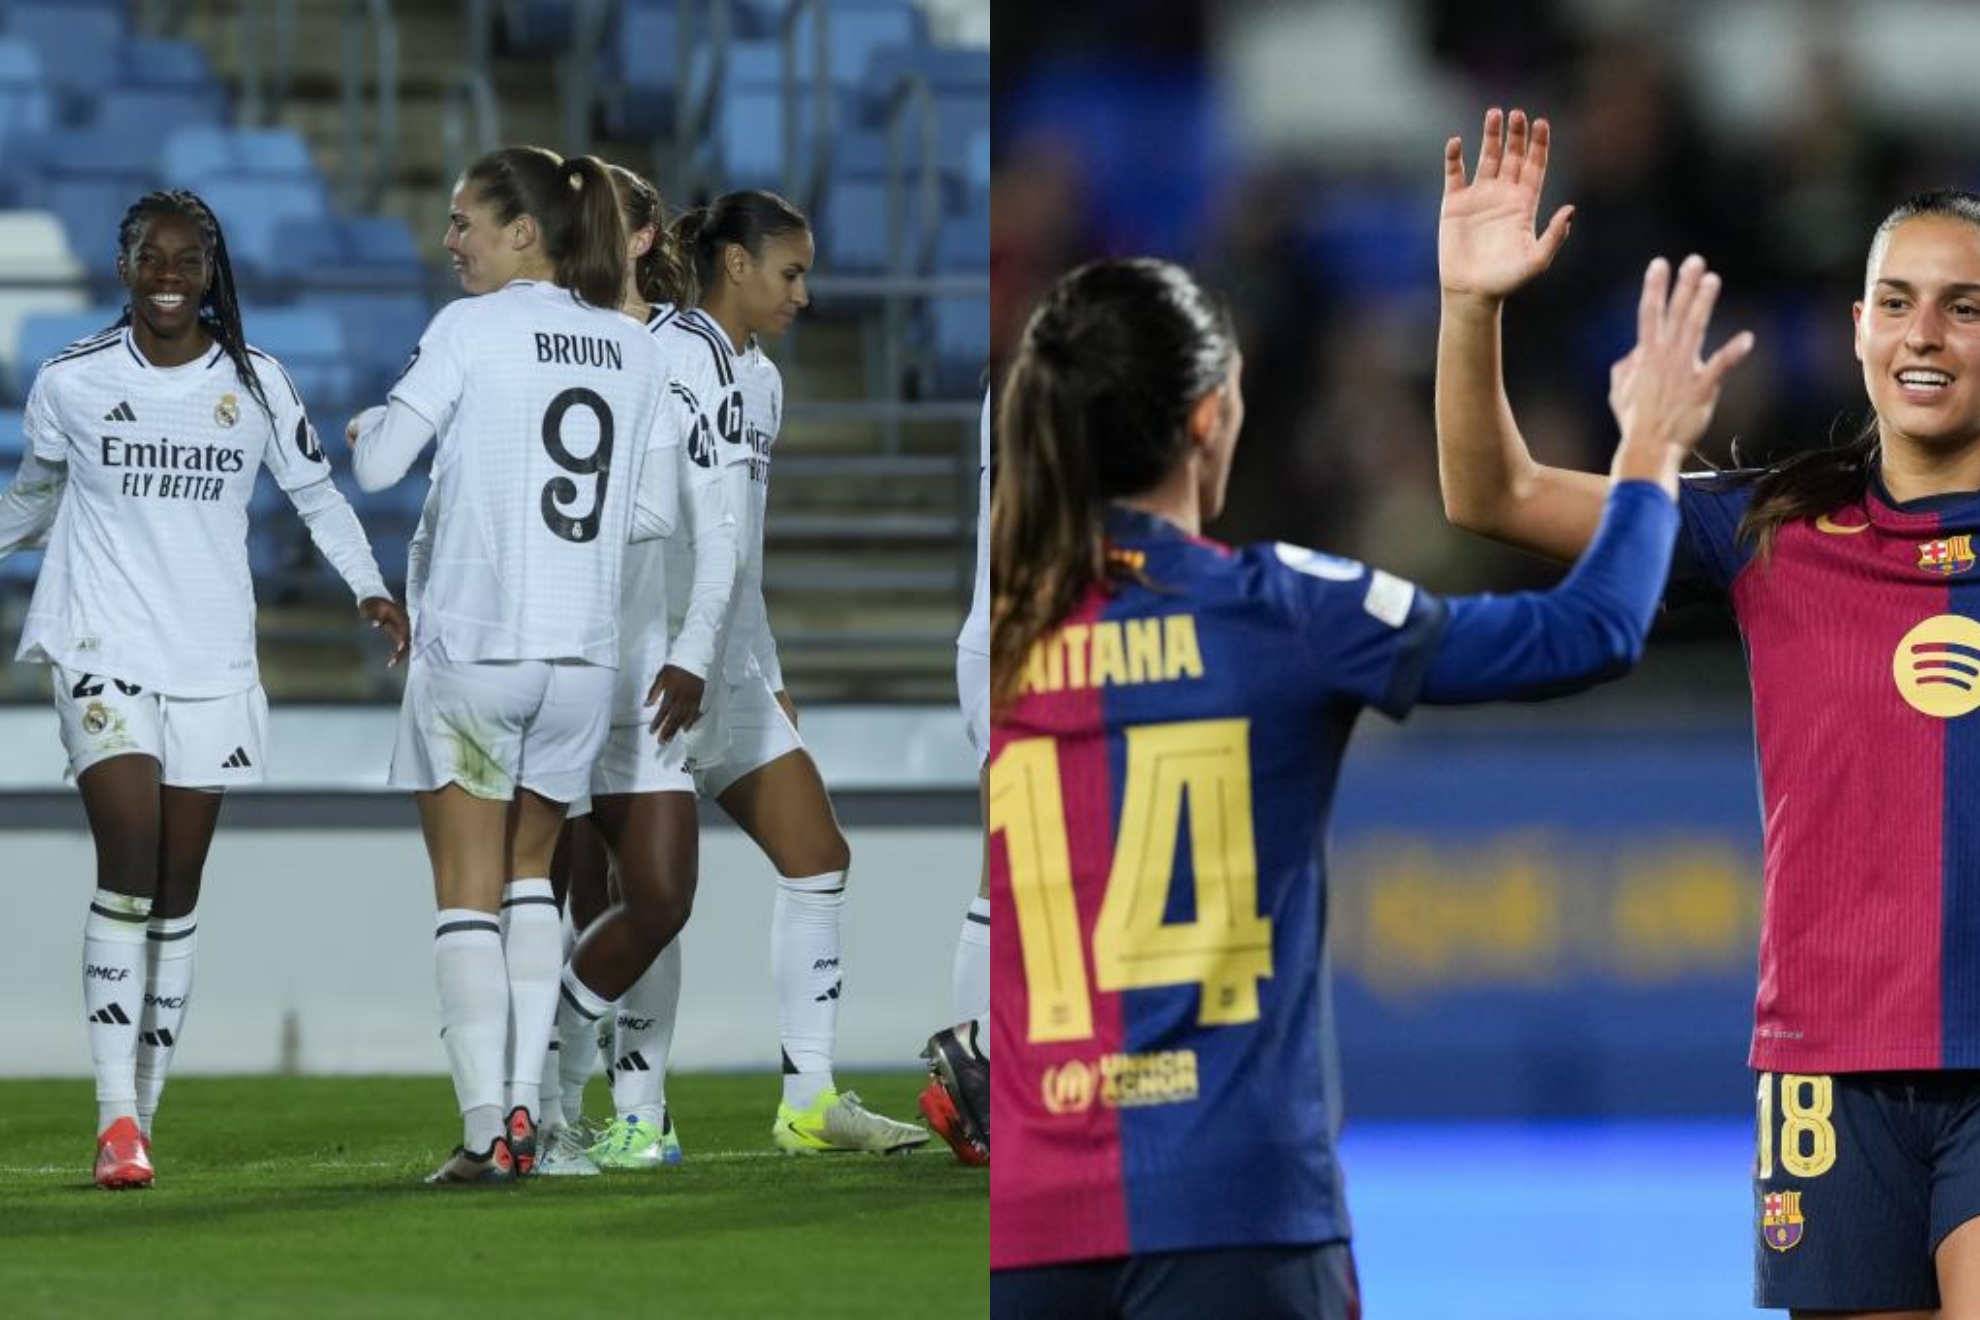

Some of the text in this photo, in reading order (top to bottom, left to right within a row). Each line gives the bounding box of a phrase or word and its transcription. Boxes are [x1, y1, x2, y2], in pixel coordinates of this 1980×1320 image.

[534, 332, 623, 371] BRUUN
[101, 436, 244, 473] Emirates
[541, 387, 614, 543] 9
[122, 472, 225, 501] FLY BETTER
[1018, 613, 1204, 694] AITANA
[989, 718, 1273, 1042] 14
[86, 965, 131, 982] RMCF
[1757, 1072, 1837, 1179] 18
